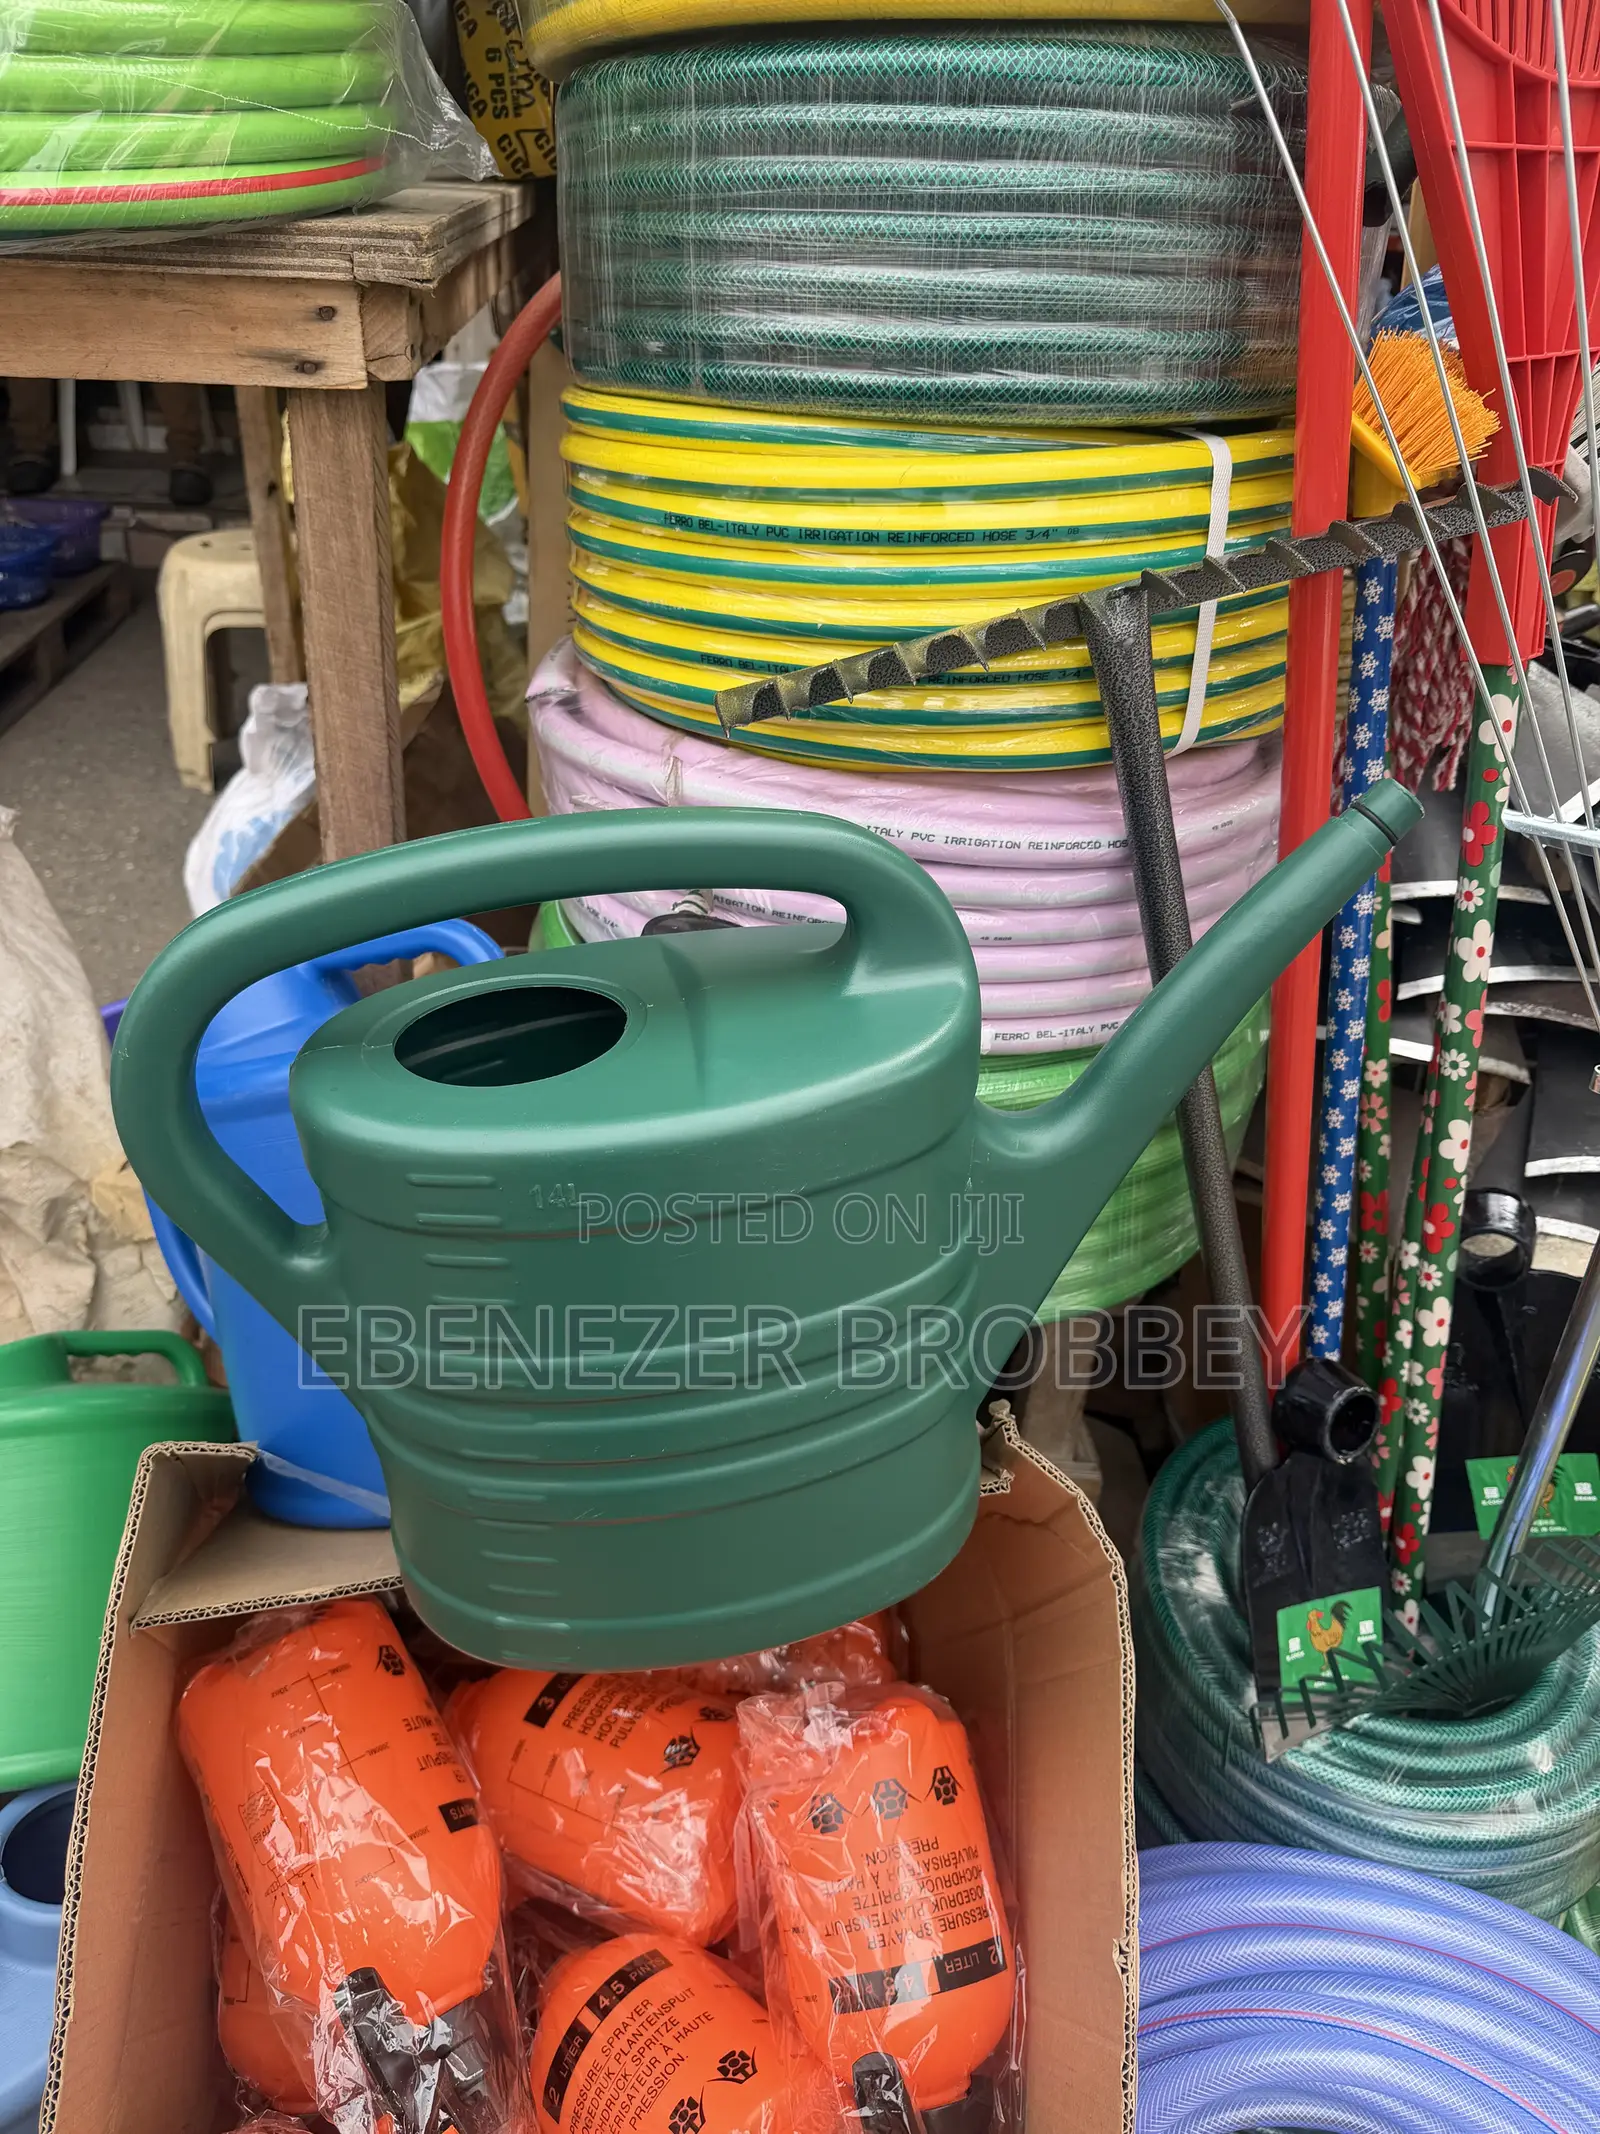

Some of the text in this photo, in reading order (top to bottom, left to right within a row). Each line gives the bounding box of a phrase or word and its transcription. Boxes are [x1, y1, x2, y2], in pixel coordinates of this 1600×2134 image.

[485, 48, 510, 120] 6 PCS
[664, 513, 693, 528] FERRO
[698, 518, 760, 537] BEL-ITALY
[766, 526, 790, 539] PVC
[798, 528, 880, 543] IRRIGATION
[887, 531, 975, 543] REINFORCED
[982, 530, 1017, 542] HOSE
[1025, 528, 1059, 540] 3/4"
[700, 653, 733, 668] FERRO
[928, 674, 1011, 685] REINFORCED
[1018, 671, 1049, 682] HOSE
[866, 825, 1129, 851] ITALY PVC IRRIGATION REINFORCED HOS
[713, 894, 766, 914] RIGATION
[993, 1021, 1119, 1042] FERRO BEL-ITALY PVC
[939, 1905, 989, 1933] RESSURE
[944, 1951, 980, 1975] LITER
[548, 1956, 666, 2107] 2 LITER 4.5 PINTS
[569, 1998, 654, 2134] PRESSURE SPRAYER
[582, 1987, 697, 2134] OGEDRUK PLANTENSPUIT
[594, 2015, 681, 2134] CHDRUCK SPRITZE
[608, 2055, 662, 2134] ÉRISATEUR
[672, 2010, 716, 2042] HAUTE
[628, 2052, 690, 2132] PRESSION.
